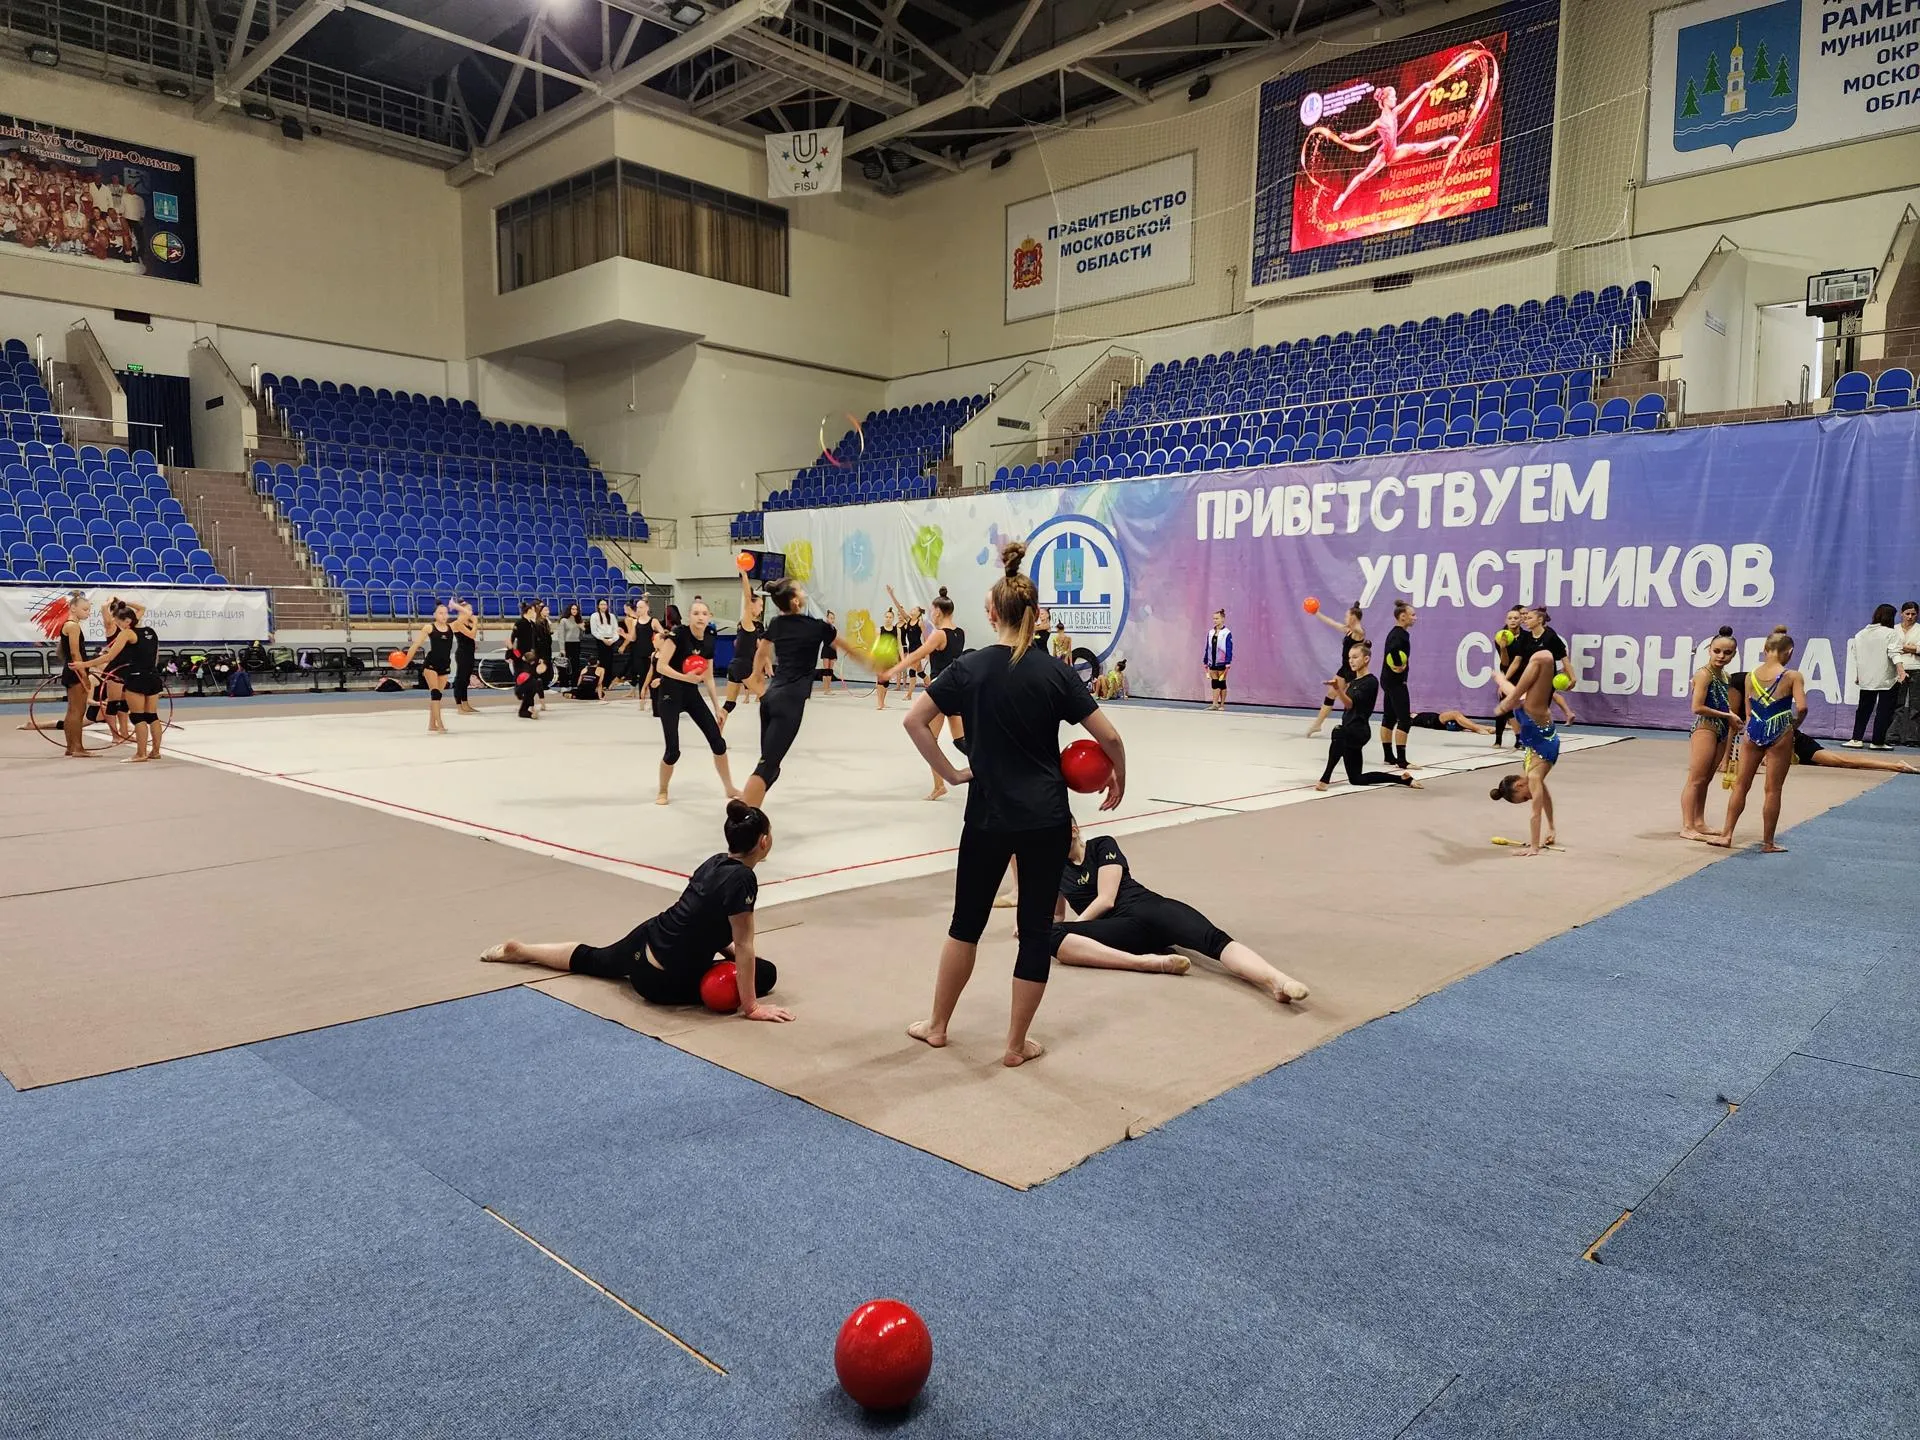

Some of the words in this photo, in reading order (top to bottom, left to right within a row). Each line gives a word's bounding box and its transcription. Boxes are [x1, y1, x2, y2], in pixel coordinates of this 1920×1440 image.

[1877, 42, 1919, 64] ОКР
[1430, 80, 1468, 107] 19-22
[1844, 64, 1920, 94] МОСКО
[1415, 110, 1466, 135] января
[28, 129, 61, 148] клуб
[793, 133, 817, 163] U
[1459, 147, 1494, 168] Кубок
[794, 181, 819, 192] FISU
[1380, 174, 1445, 203] Московской
[1446, 166, 1493, 187] области
[1048, 191, 1187, 240] ПРАВИТЕЛЬСТВО
[1060, 214, 1171, 258] МОСКОВСКОЙ
[1077, 243, 1152, 273] ОБЛАСТИ
[1197, 460, 1611, 541] ПРИВЕТСТВУЕМ
[1357, 543, 1775, 609] УЧАСТНИКОВ
[184, 610, 245, 620] ФЕДЕРАЦИЯ
